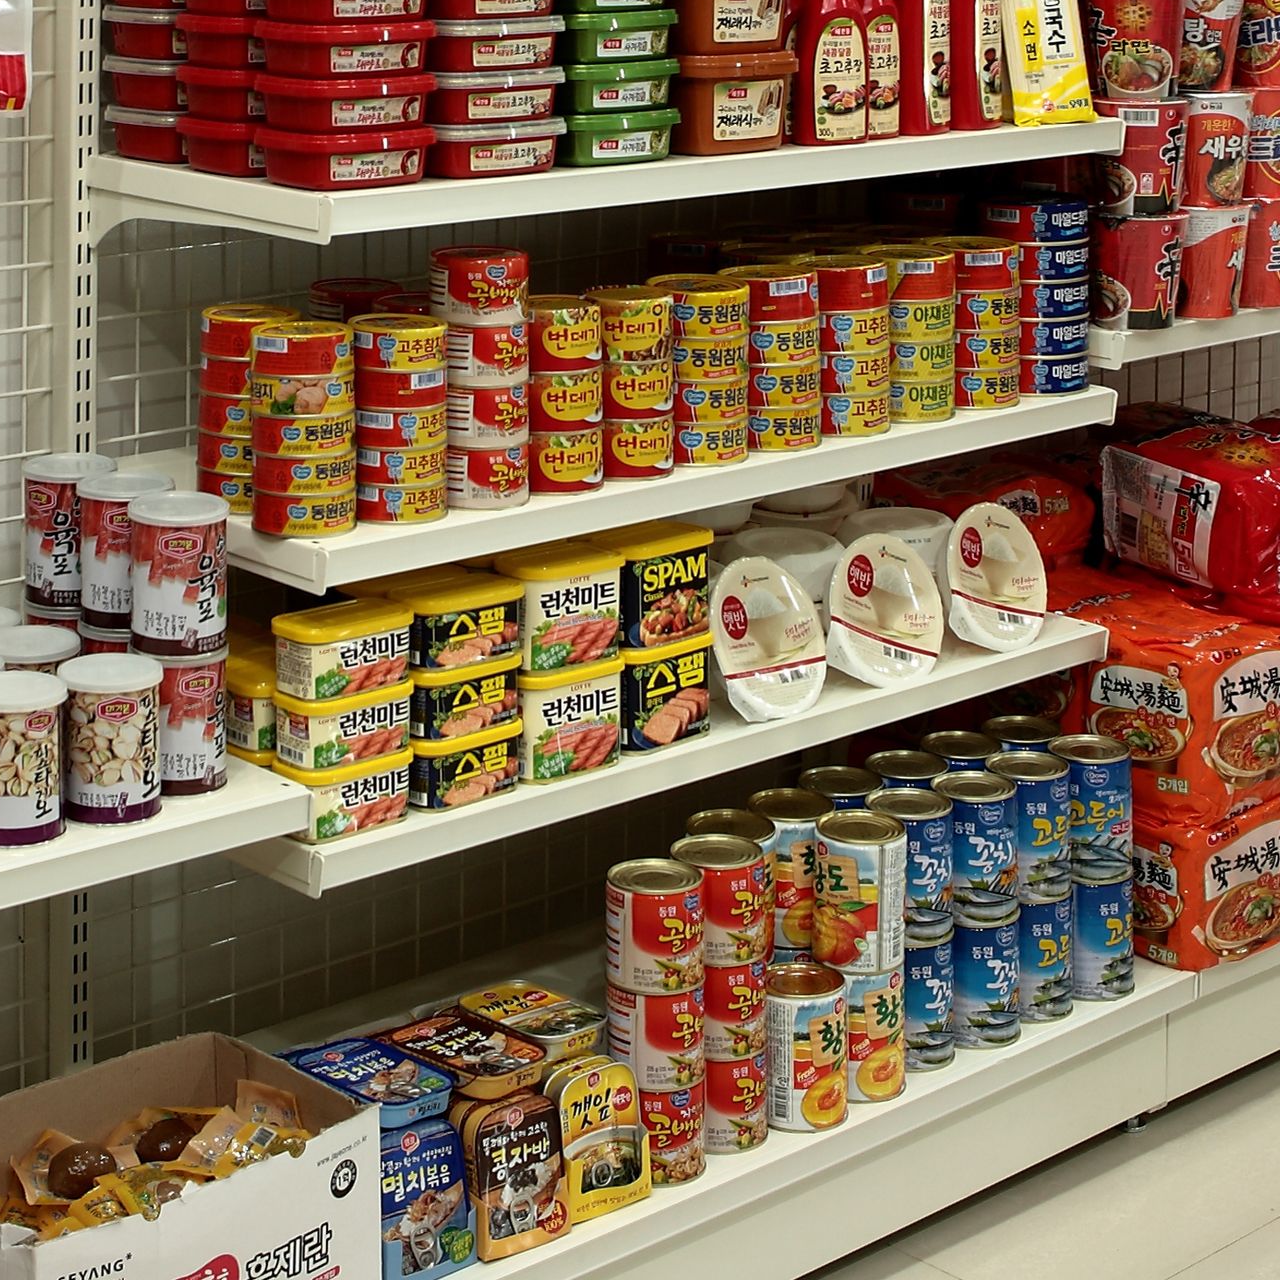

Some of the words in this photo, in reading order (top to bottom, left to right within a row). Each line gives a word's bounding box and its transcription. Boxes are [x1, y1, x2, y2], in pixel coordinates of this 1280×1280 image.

[715, 16, 753, 31] 재래식
[822, 47, 852, 57] 새콤달콤
[1022, 19, 1038, 62] 소면
[1111, 39, 1151, 57] 라면
[819, 57, 863, 75] 초고추장
[715, 113, 753, 128] 재래식
[1201, 119, 1236, 133] 개운한!
[818, 128, 835, 138] 300g
[467, 279, 522, 308] 골뱅이
[546, 328, 600, 351] 번데기
[689, 345, 746, 368] 동원참치
[545, 385, 599, 409] 번데기
[614, 376, 670, 399] 번데기
[41, 510, 77, 578] 육포
[165, 535, 196, 553] 머거본
[569, 575, 590, 584] LOTTE
[642, 551, 708, 592] SPAM
[848, 567, 873, 593] 햇반
[186, 552, 218, 625] 육포
[539, 581, 618, 618] 런천미트
[643, 591, 665, 603] Classic
[449, 608, 507, 642] 스팸
[721, 611, 746, 631] 햇반
[340, 631, 411, 668] 런천미트
[569, 682, 593, 691] LOTTE
[645, 657, 706, 694] 스팸
[103, 701, 133, 717] 머거본
[541, 687, 619, 727] 런천미트
[340, 703, 411, 740] 런천미트
[340, 772, 411, 808] 런천미트
[1156, 776, 1190, 796] 5개입
[954, 821, 976, 835] 동원
[1070, 798, 1125, 839] 고등어
[968, 834, 1019, 881] 꽁치
[777, 886, 798, 903] Fresh
[658, 905, 677, 918] 동원
[1147, 945, 1178, 965] 5개입
[851, 1037, 872, 1056] Fresh
[570, 1086, 614, 1130] 깻잎
[643, 1100, 664, 1112] 동원
[491, 1139, 551, 1182] 콩자반
[381, 1162, 452, 1203] 멸치볶음
